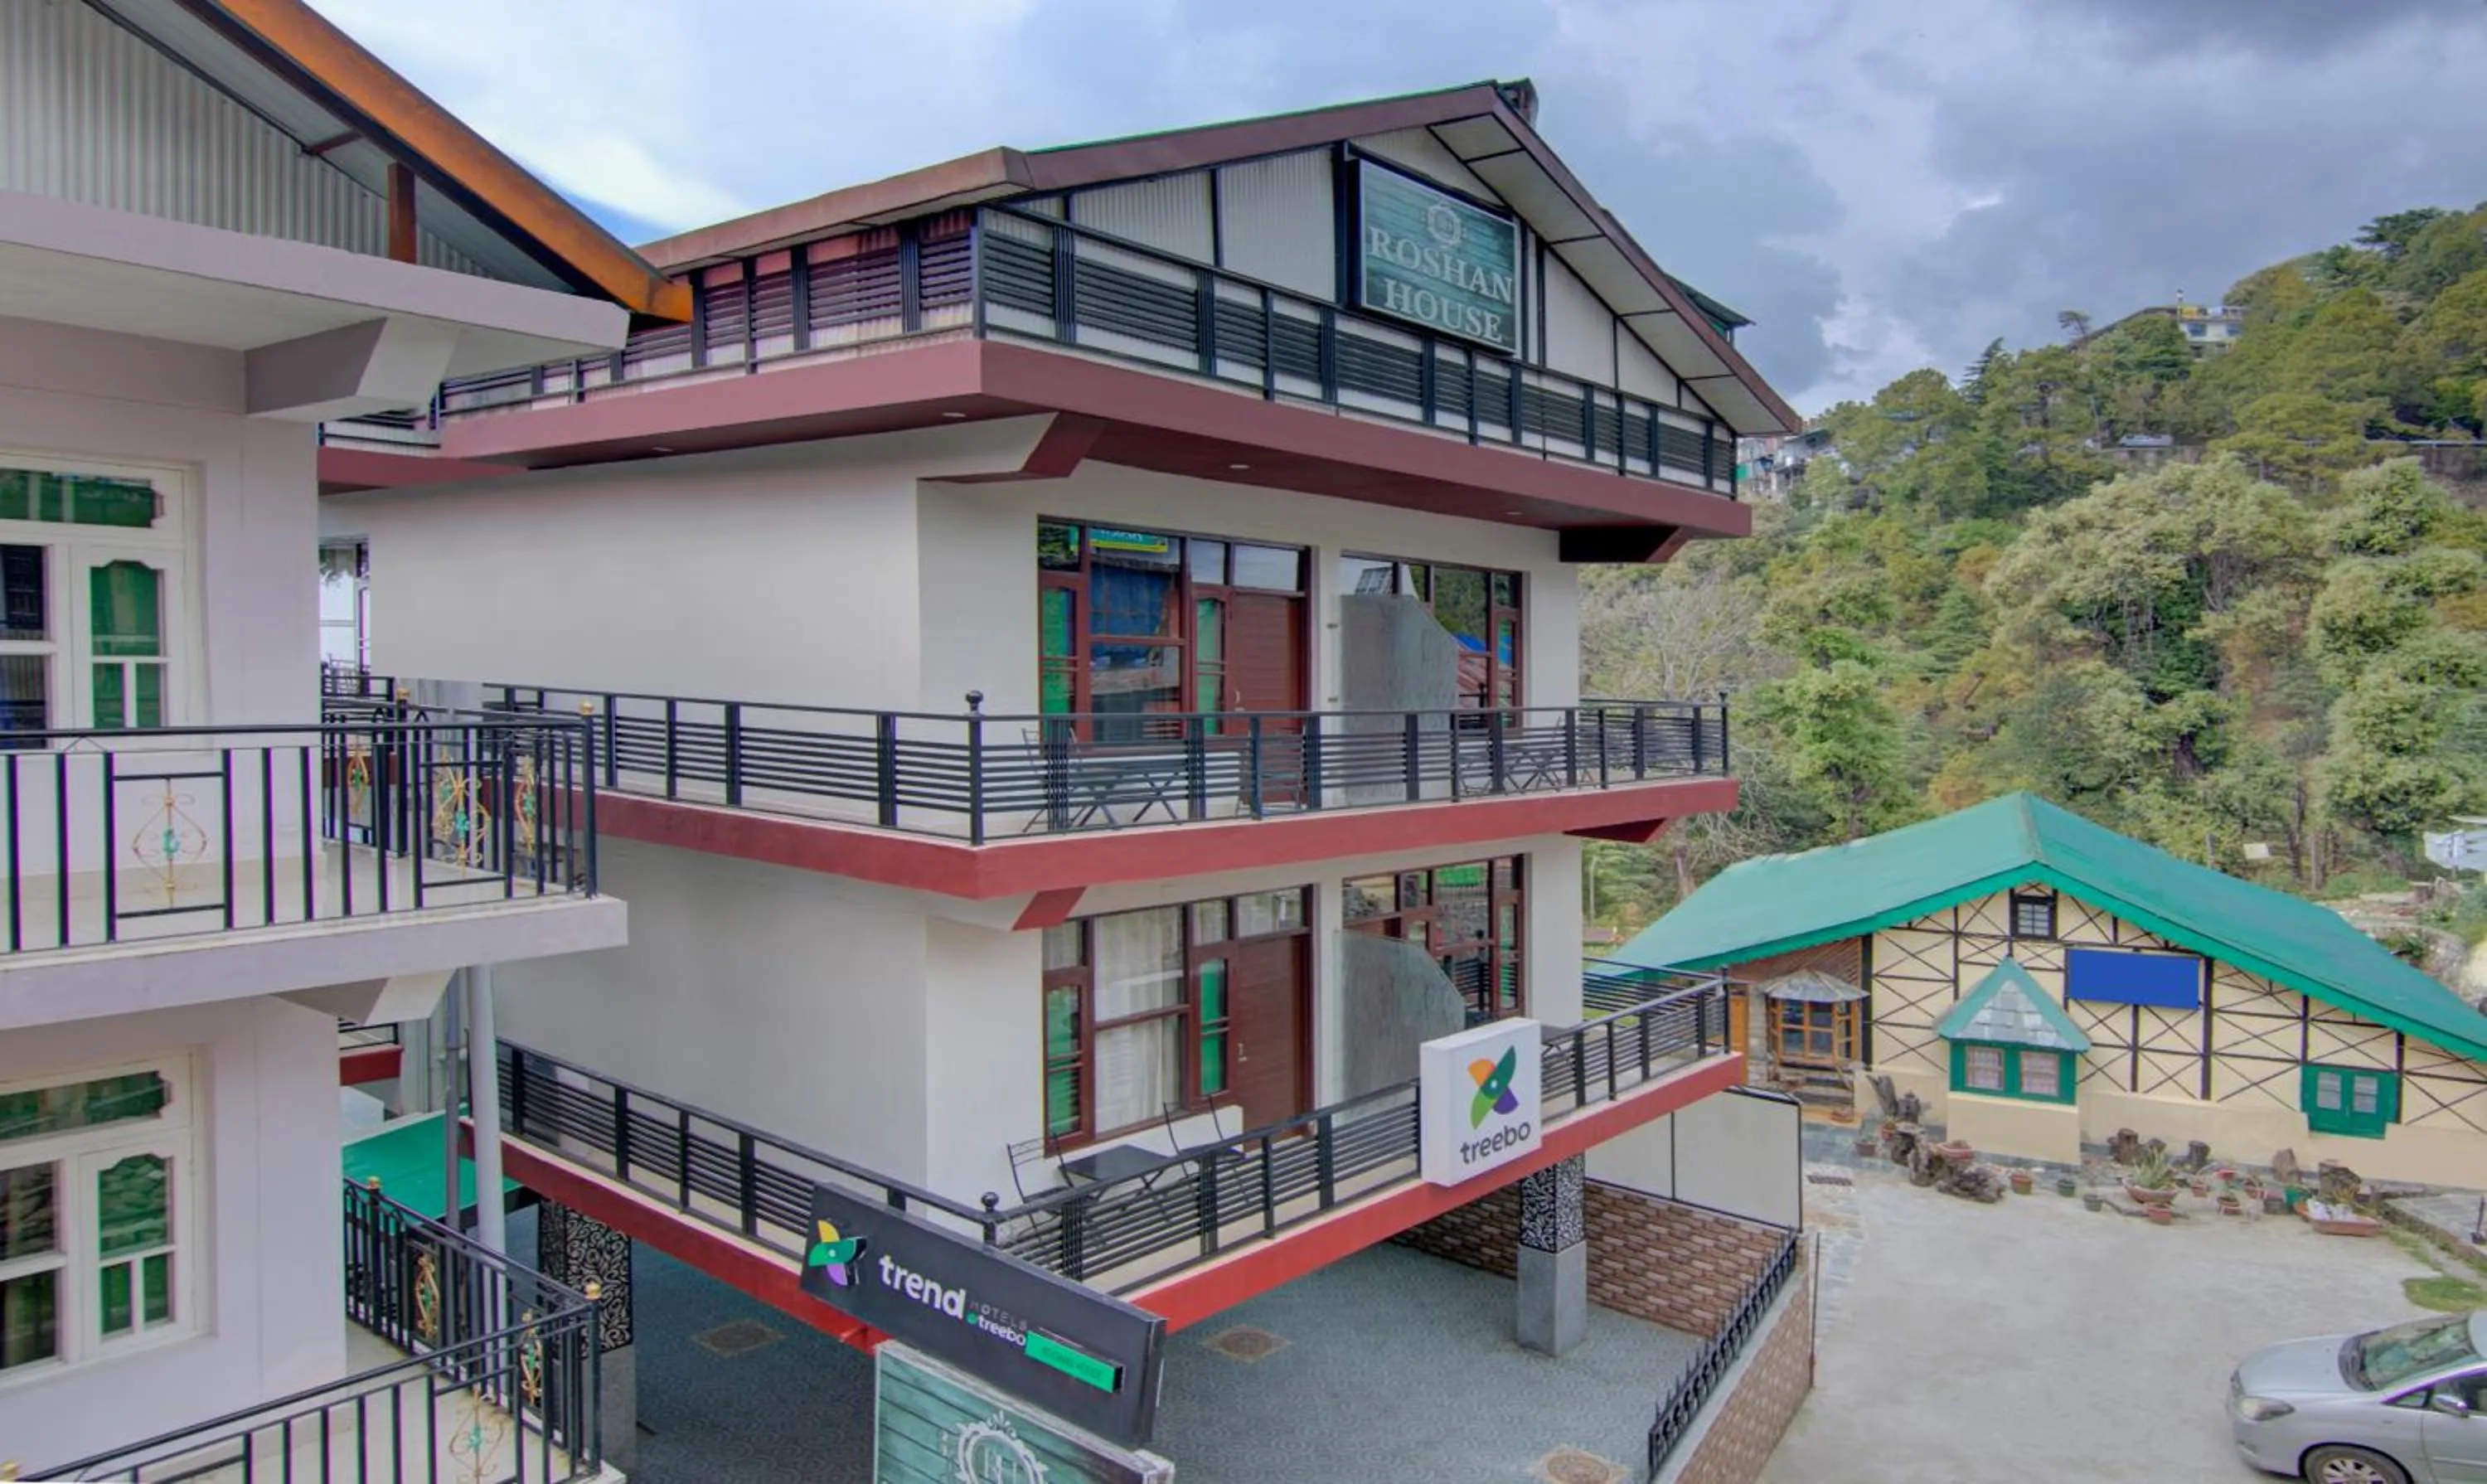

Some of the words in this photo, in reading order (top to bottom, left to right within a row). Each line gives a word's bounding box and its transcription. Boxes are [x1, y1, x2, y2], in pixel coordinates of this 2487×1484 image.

[1369, 226, 1513, 303] ROSHAN
[1384, 278, 1502, 343] HOUSE
[1460, 1121, 1531, 1165] treebo
[879, 1254, 967, 1320] trend
[978, 1315, 1026, 1346] treebo
